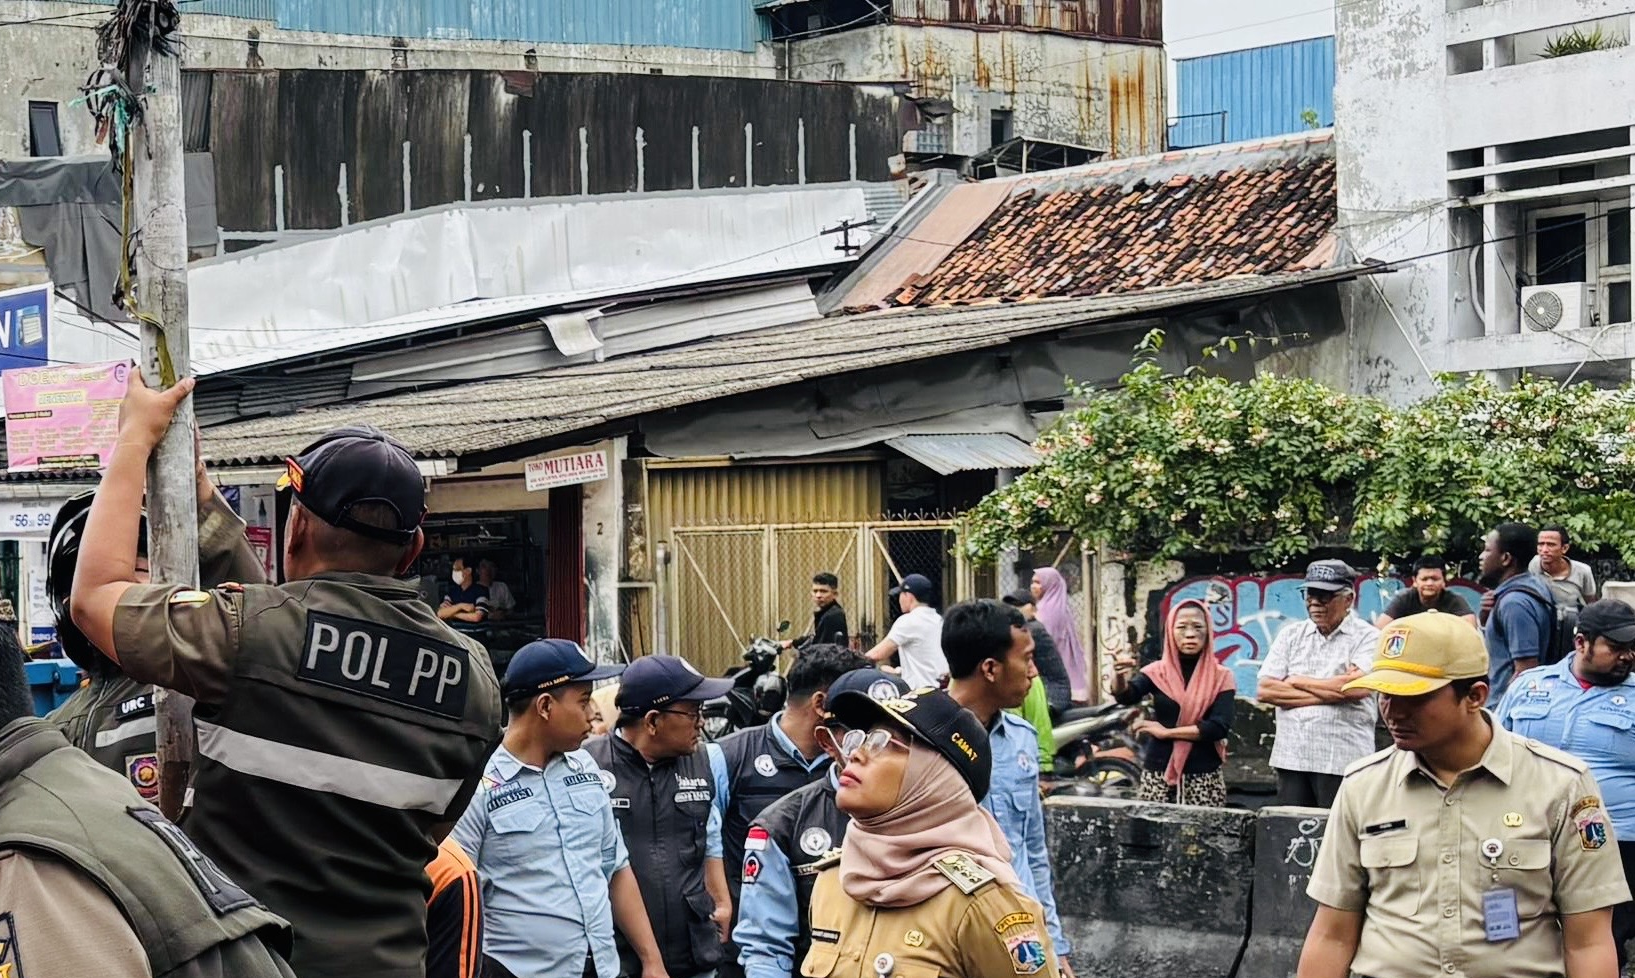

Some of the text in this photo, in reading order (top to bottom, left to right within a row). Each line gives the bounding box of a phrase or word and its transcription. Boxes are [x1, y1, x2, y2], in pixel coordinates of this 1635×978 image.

[544, 453, 604, 475] MUTIARA
[37, 513, 51, 526] 99
[305, 621, 464, 706] POL PP
[121, 696, 145, 714] URC
[951, 731, 978, 762] CAMAT
